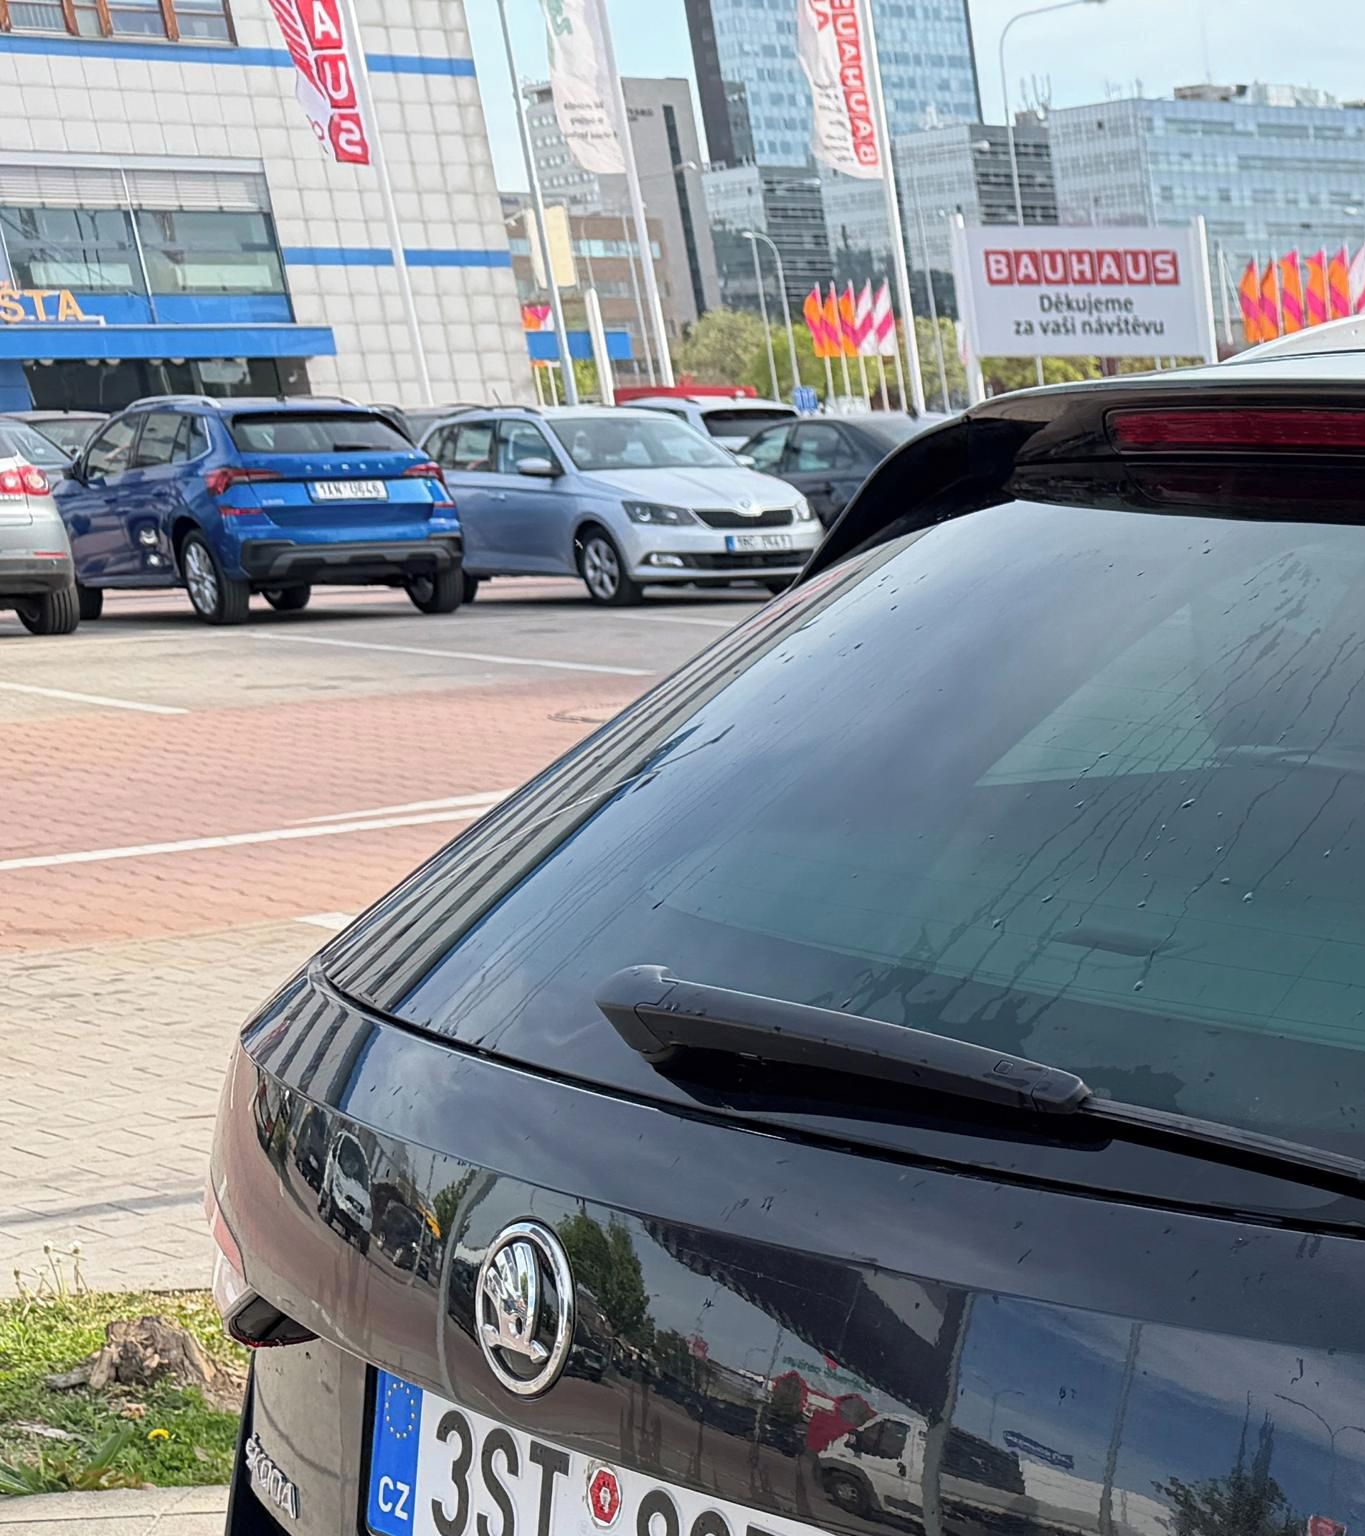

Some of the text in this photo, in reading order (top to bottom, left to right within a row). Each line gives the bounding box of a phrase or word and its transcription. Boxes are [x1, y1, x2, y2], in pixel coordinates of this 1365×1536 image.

[986, 251, 1178, 283] BAUHAUS
[1038, 292, 1134, 317] Děkujeme
[1014, 315, 1165, 336] za vaši návštěvu
[377, 1475, 411, 1521] CZ
